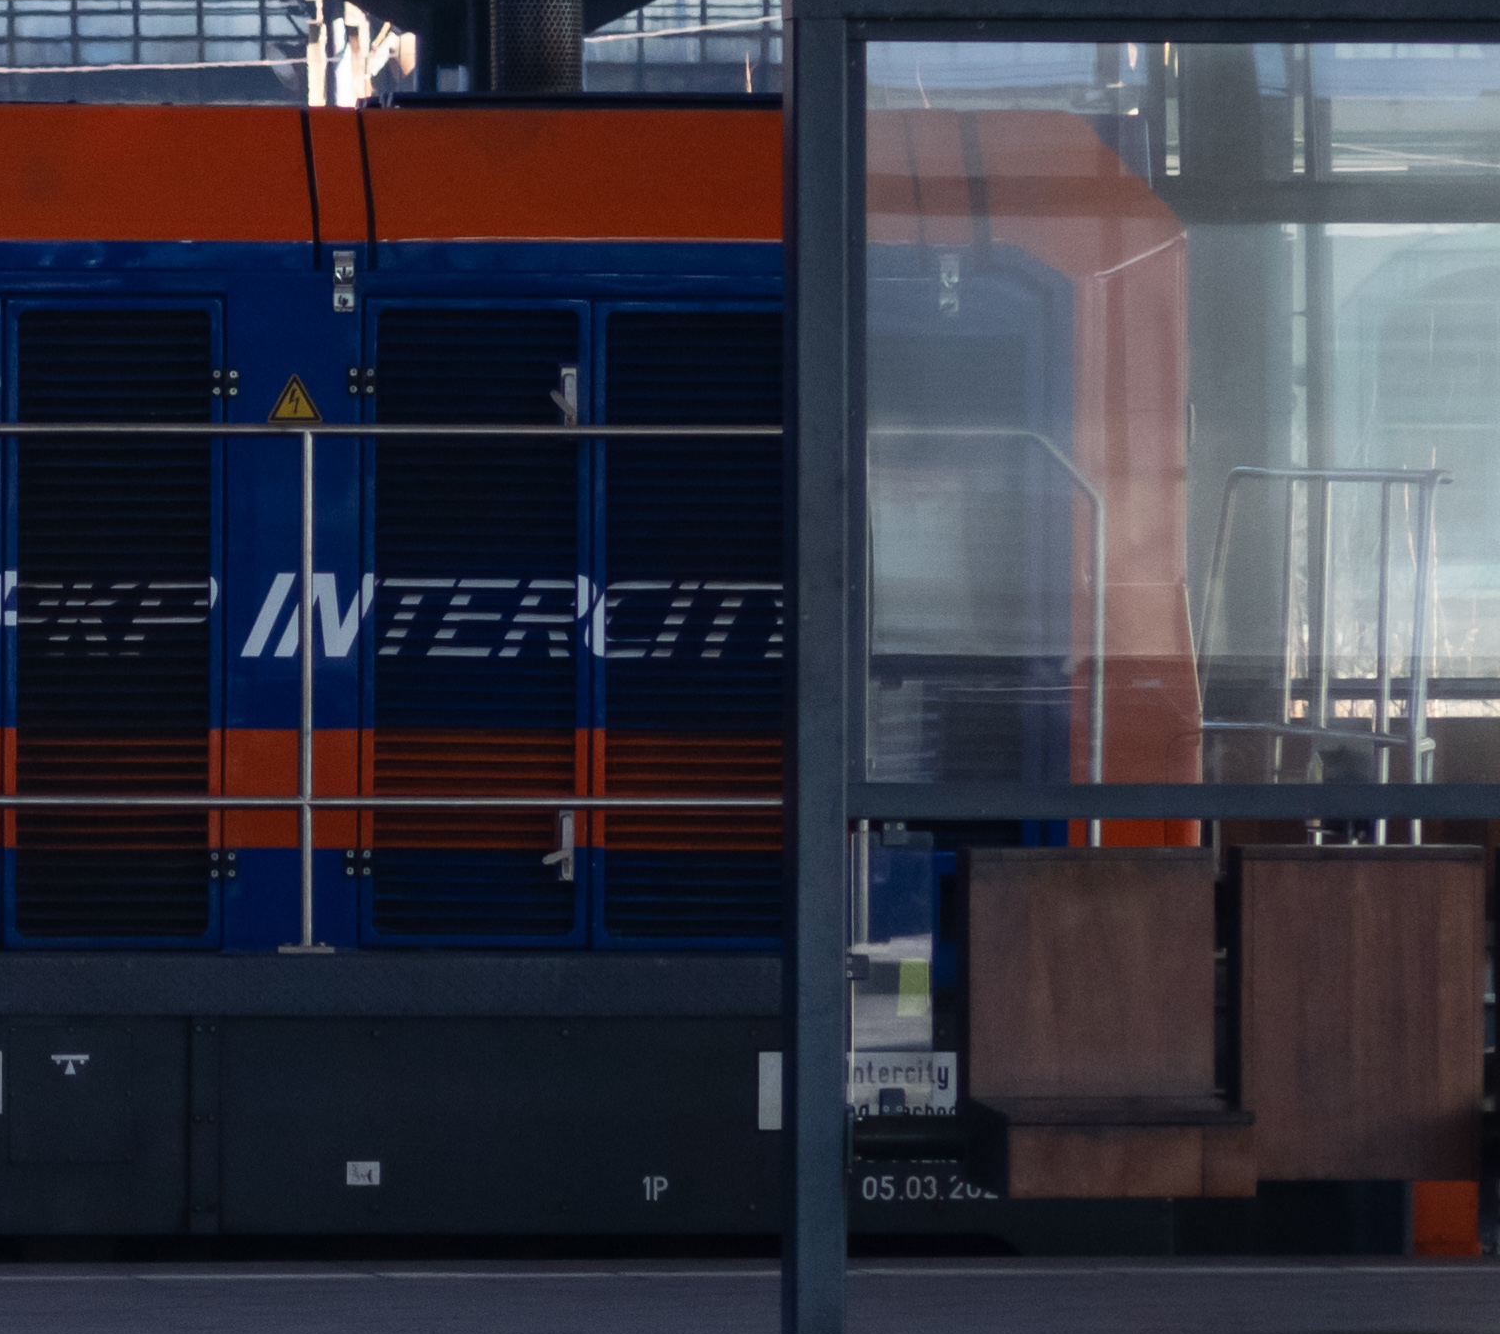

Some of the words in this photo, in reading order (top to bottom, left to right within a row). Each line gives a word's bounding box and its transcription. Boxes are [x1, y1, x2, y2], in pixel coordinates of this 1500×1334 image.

[241, 572, 784, 657] INTERCIT
[853, 1060, 949, 1090] ntercity
[643, 1176, 669, 1201] 1P
